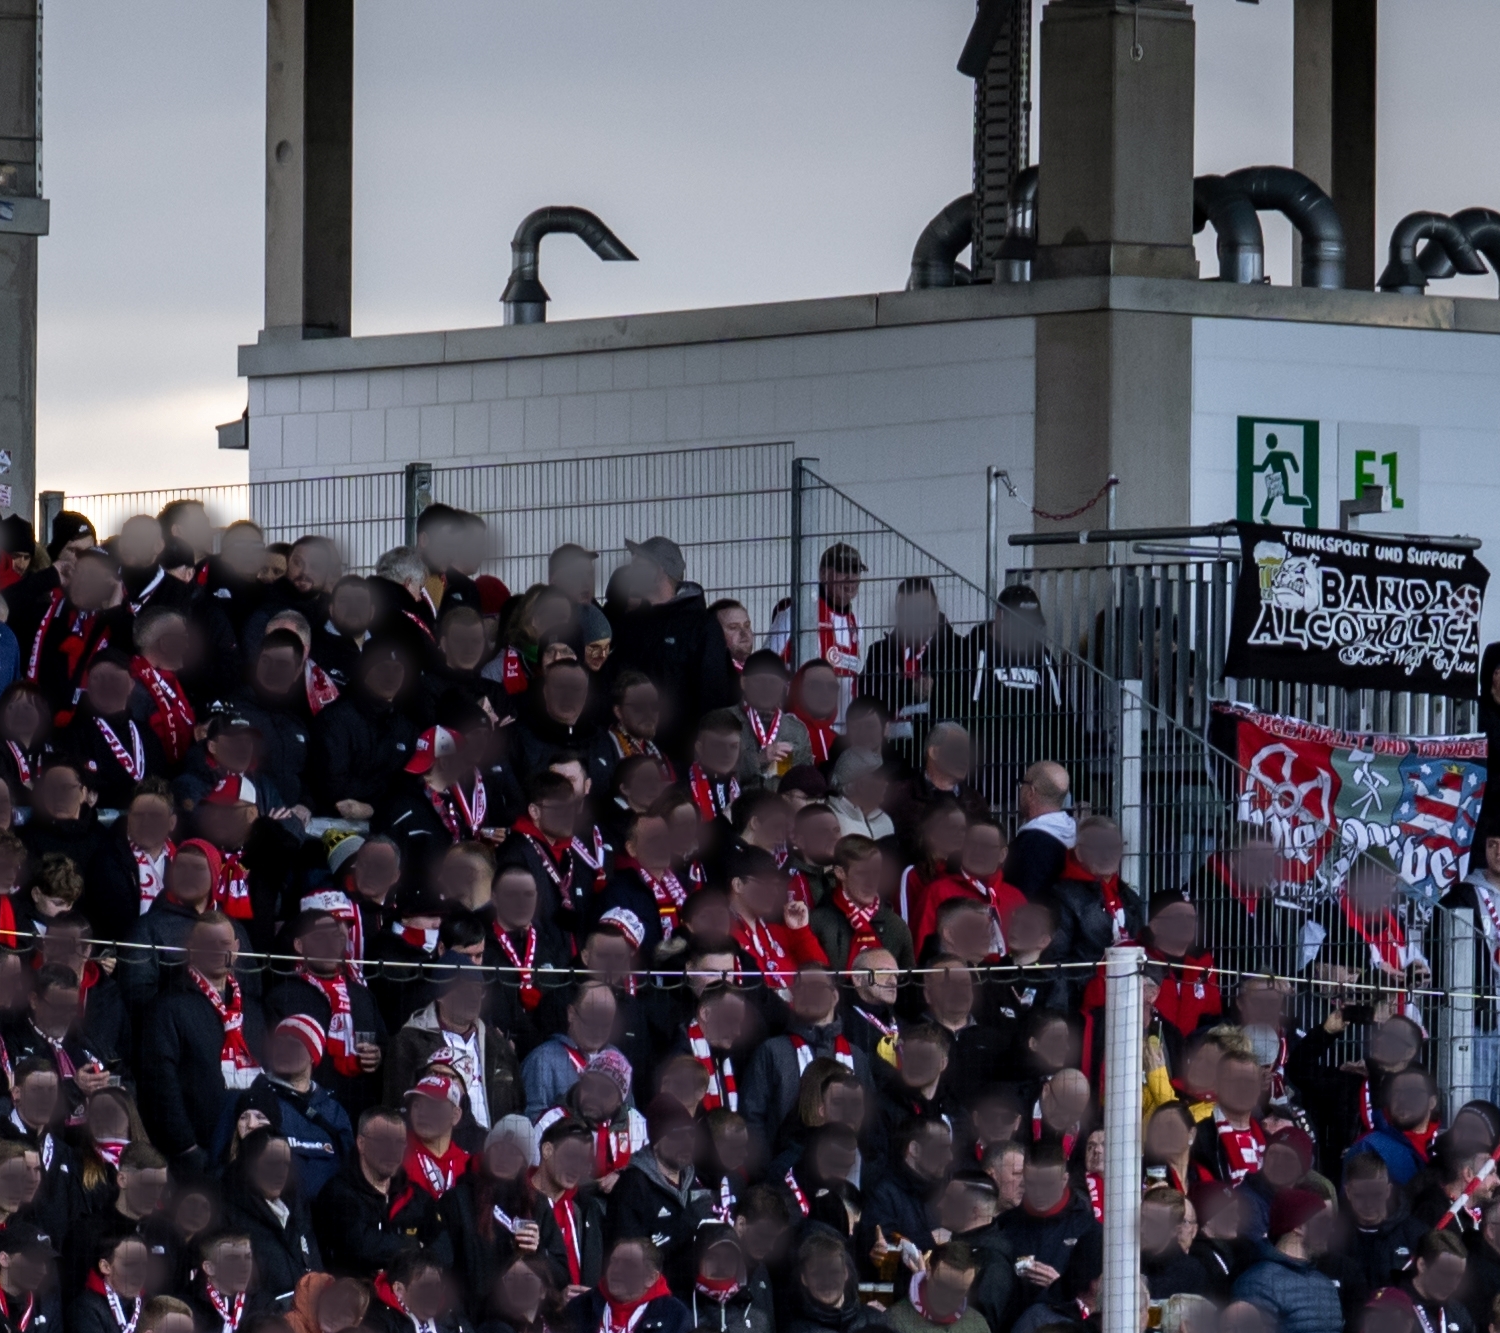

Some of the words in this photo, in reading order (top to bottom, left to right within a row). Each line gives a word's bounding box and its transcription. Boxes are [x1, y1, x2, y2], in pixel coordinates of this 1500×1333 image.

[1283, 531, 1369, 558] TRINKSPORT
[1375, 546, 1402, 562] UND
[1407, 546, 1465, 570] SUPPORT
[1318, 566, 1452, 616] BANDA
[1248, 601, 1479, 653] ALCOHOLICA
